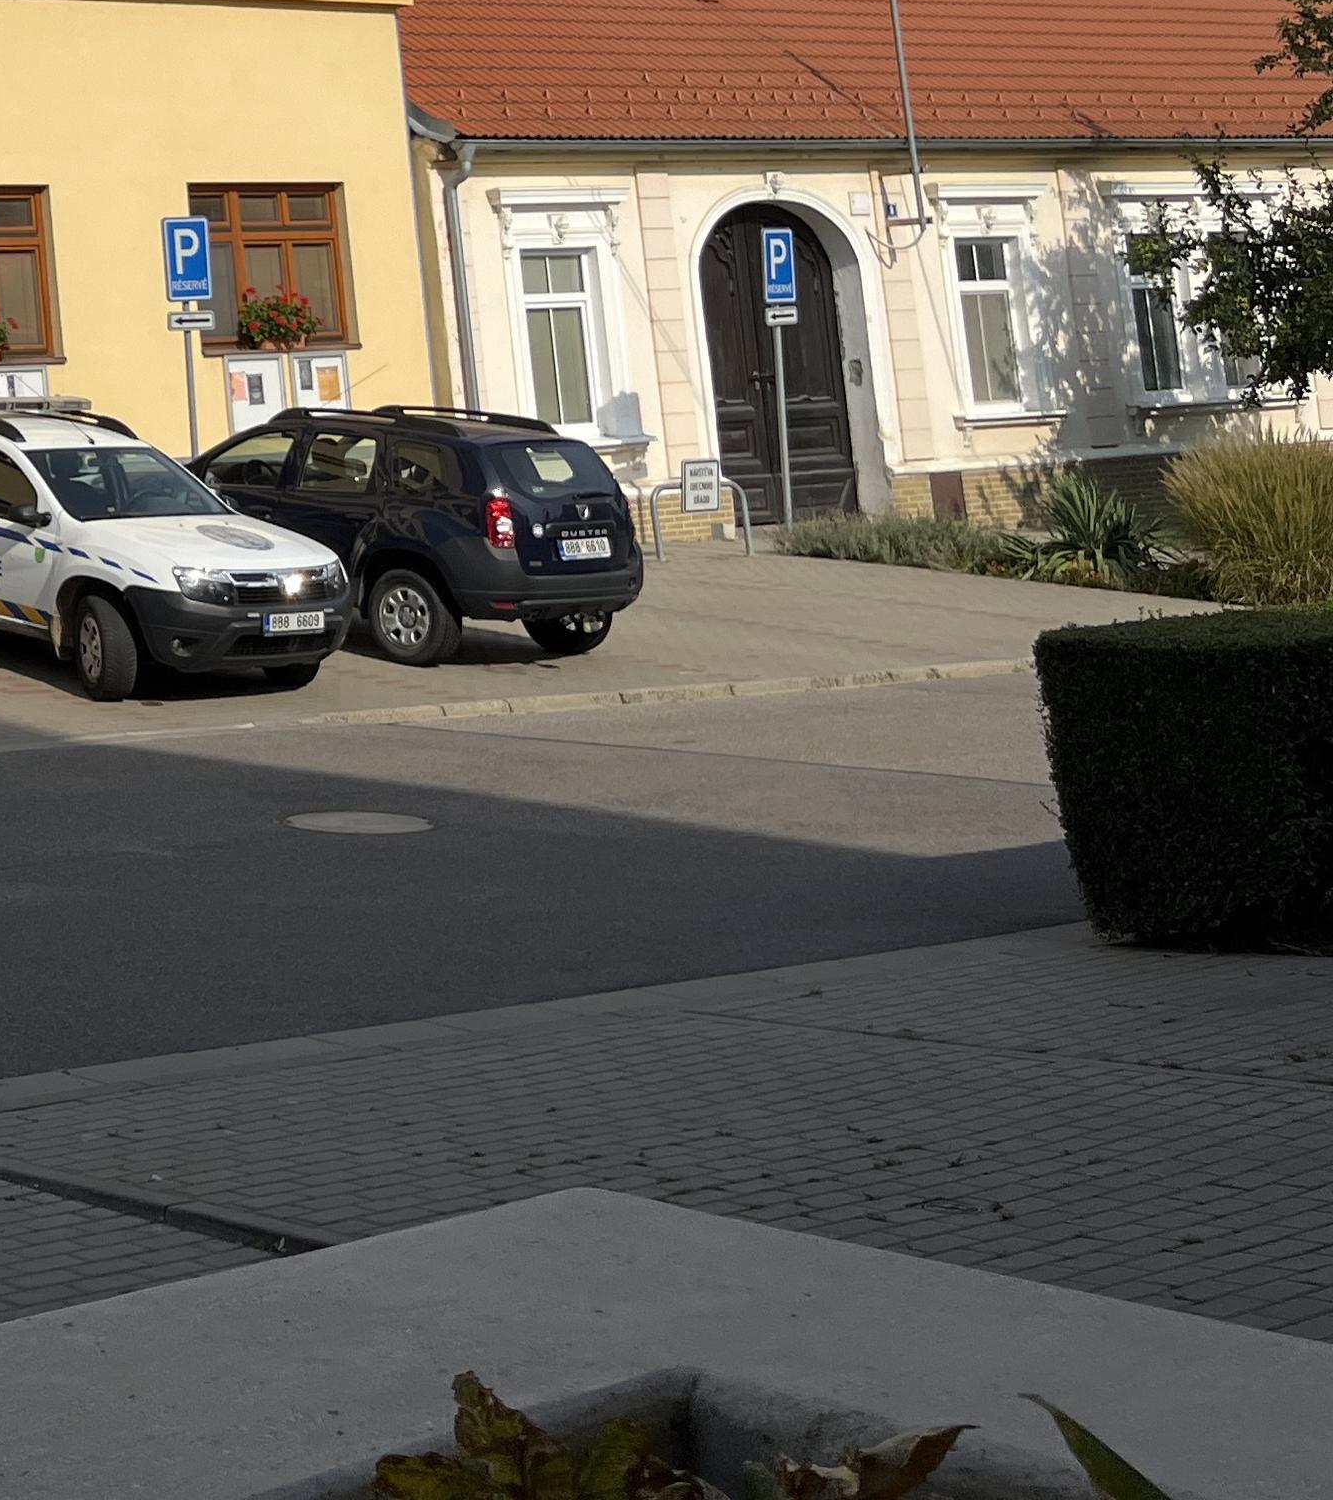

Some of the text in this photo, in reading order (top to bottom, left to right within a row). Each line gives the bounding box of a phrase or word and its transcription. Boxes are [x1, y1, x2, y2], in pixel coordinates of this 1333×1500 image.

[173, 228, 200, 275] P
[769, 238, 787, 280] P
[561, 528, 608, 538] DUSTER
[585, 539, 606, 553] 6610
[296, 613, 320, 628] 6609
